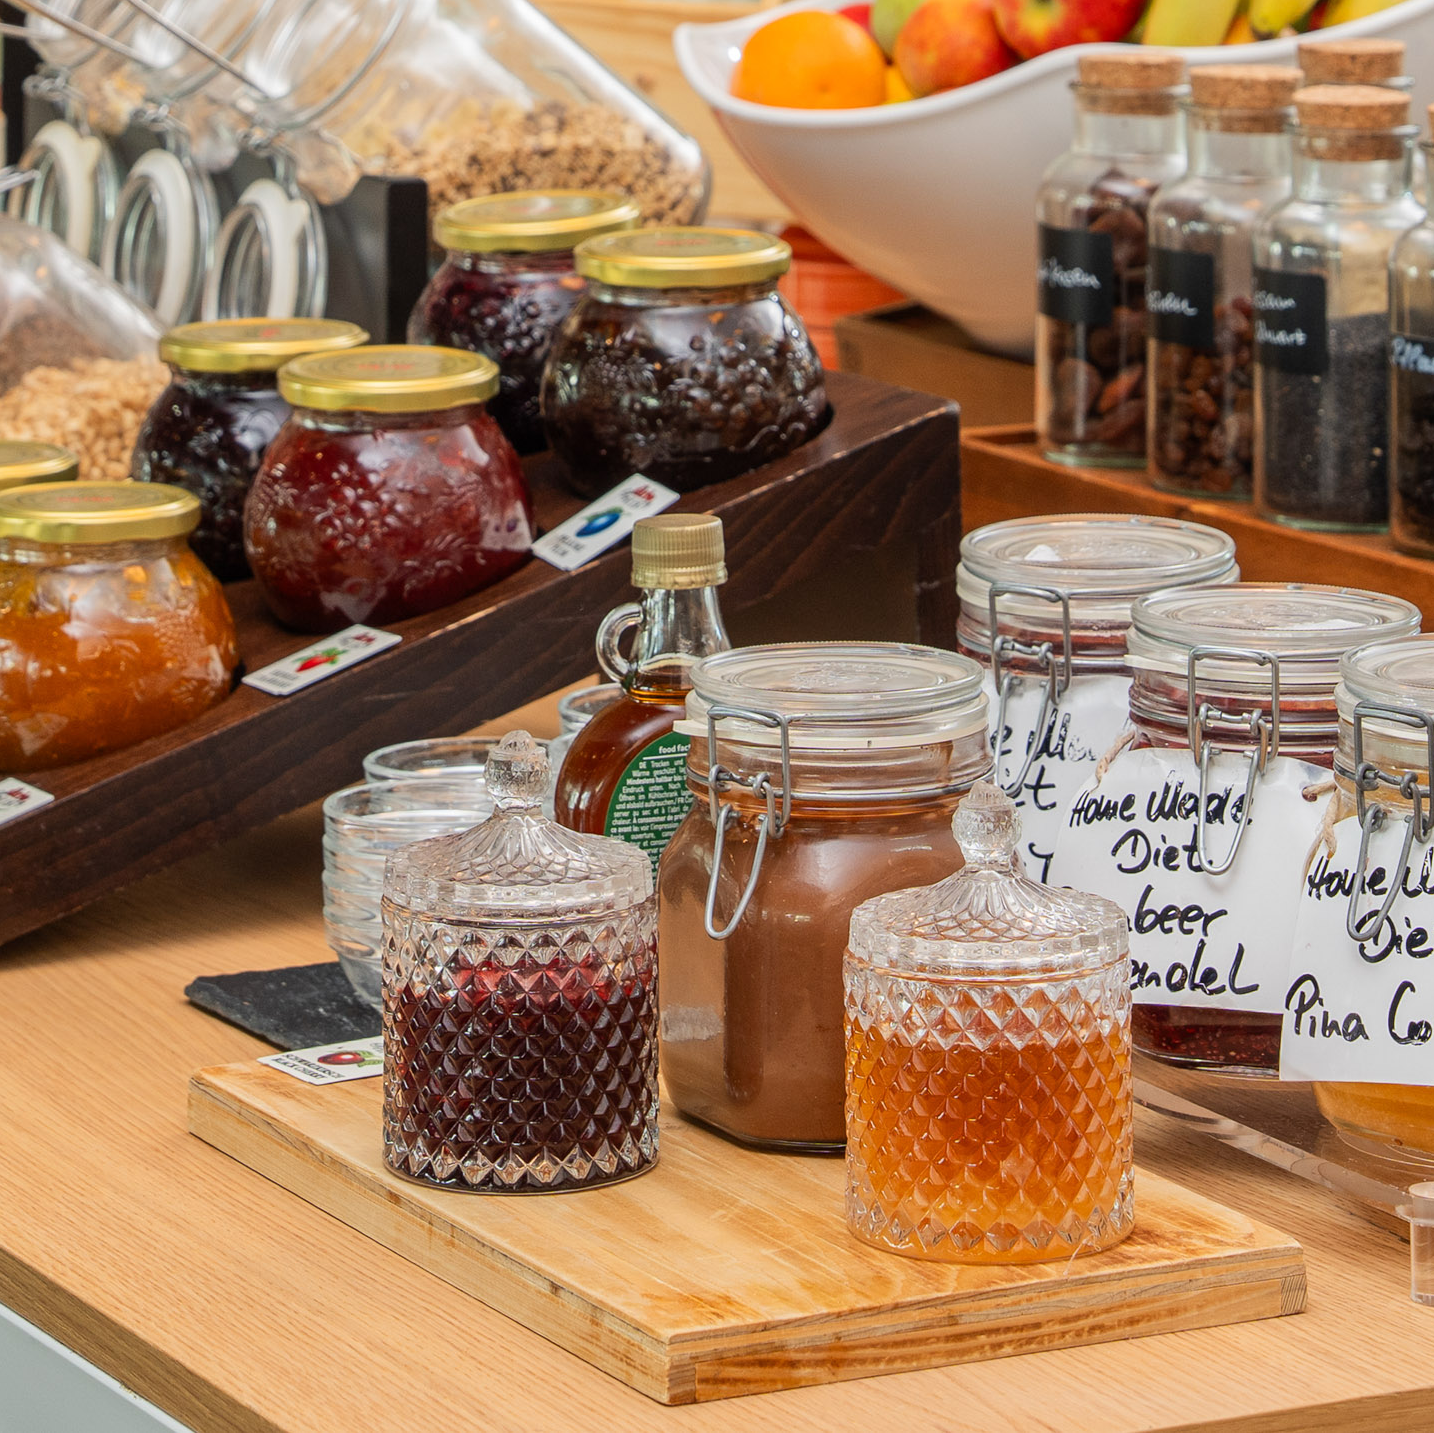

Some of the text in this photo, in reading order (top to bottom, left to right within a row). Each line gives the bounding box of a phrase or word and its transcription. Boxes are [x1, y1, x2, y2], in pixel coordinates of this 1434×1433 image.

[659, 745, 676, 754] food
[1069, 789, 1137, 828] Home
[1146, 769, 1255, 825] Made
[1110, 823, 1215, 874] Diet
[1308, 855, 1389, 901] Home
[1127, 883, 1228, 937] beer
[1284, 973, 1371, 1042] Pina
